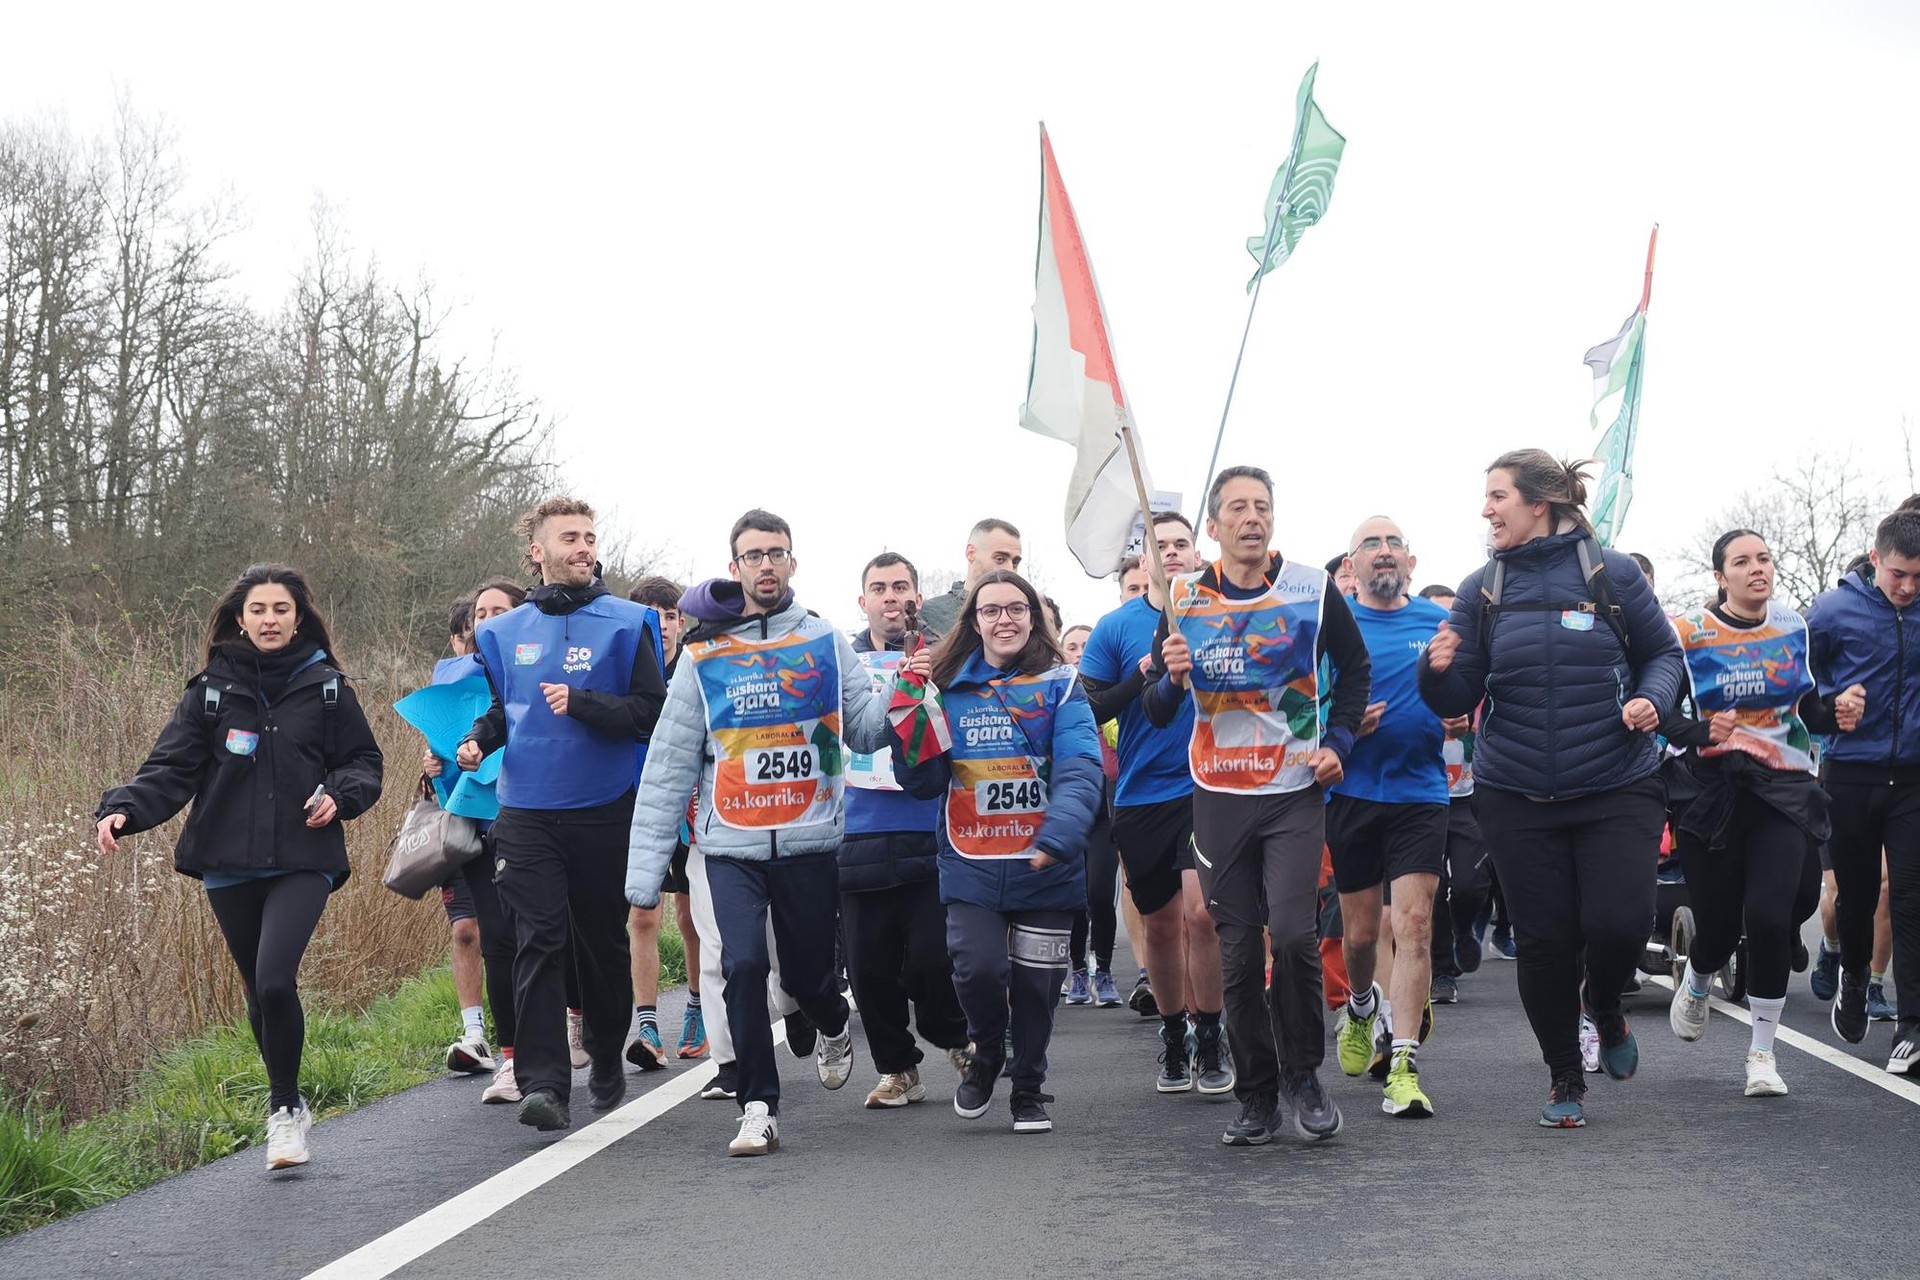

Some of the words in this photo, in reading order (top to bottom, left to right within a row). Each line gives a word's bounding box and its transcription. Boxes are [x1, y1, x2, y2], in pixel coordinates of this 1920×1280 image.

[1194, 645, 1243, 661] Euskara
[1202, 658, 1244, 679] gara
[1716, 670, 1763, 685] Euskara
[725, 681, 778, 699] Euskara
[1723, 680, 1766, 701] gara
[733, 692, 780, 715] gara
[959, 713, 1011, 728] Euskara
[965, 726, 1013, 747] gara
[757, 750, 812, 780] 2549
[1197, 752, 1275, 774] 24.korrika
[722, 788, 805, 811] 24.korrika
[987, 781, 1041, 811] 2549
[958, 819, 1035, 839] 24.korrika
[1037, 942, 1067, 957] FIG
